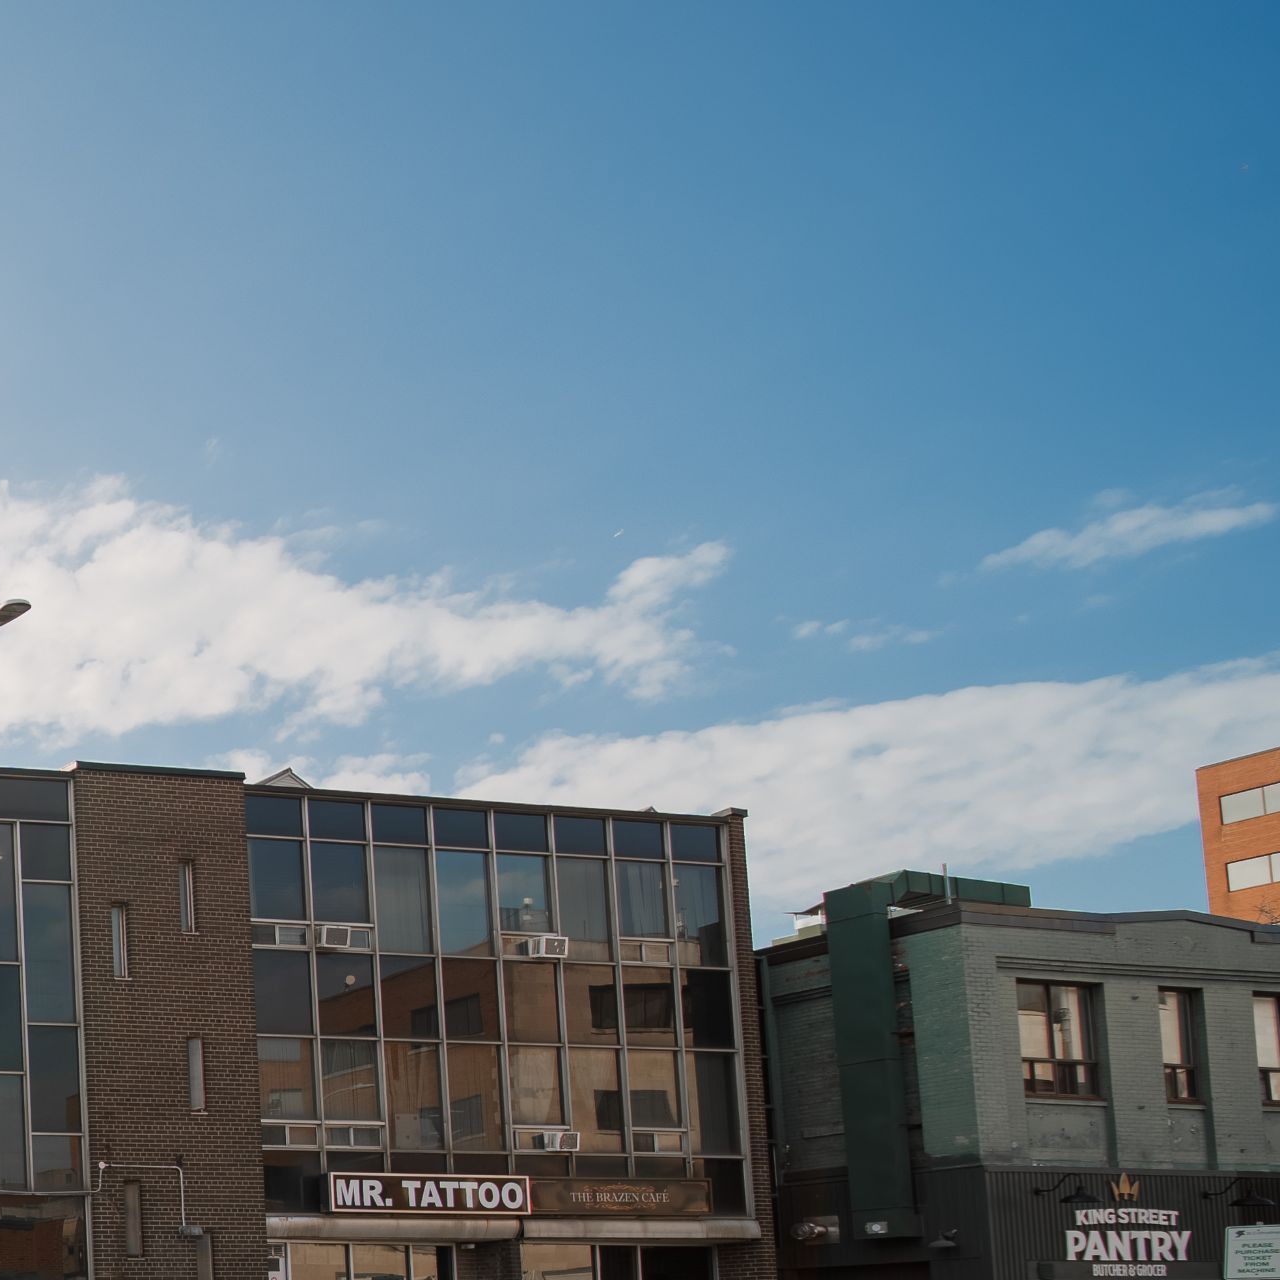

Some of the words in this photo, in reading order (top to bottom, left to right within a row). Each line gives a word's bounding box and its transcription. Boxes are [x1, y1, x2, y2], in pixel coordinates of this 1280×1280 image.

[335, 1178, 392, 1206] MR.
[401, 1180, 523, 1209] TATTOO
[570, 1192, 594, 1202] THE
[596, 1192, 639, 1202] BRAZEN
[641, 1188, 670, 1203] CAFÉ
[1075, 1208, 1117, 1226] KING
[1117, 1207, 1179, 1226] STREET
[1065, 1230, 1193, 1261] PANTRY
[1092, 1264, 1128, 1277] BUTCHER
[1128, 1265, 1136, 1277] &
[1136, 1265, 1168, 1277] GROCER
